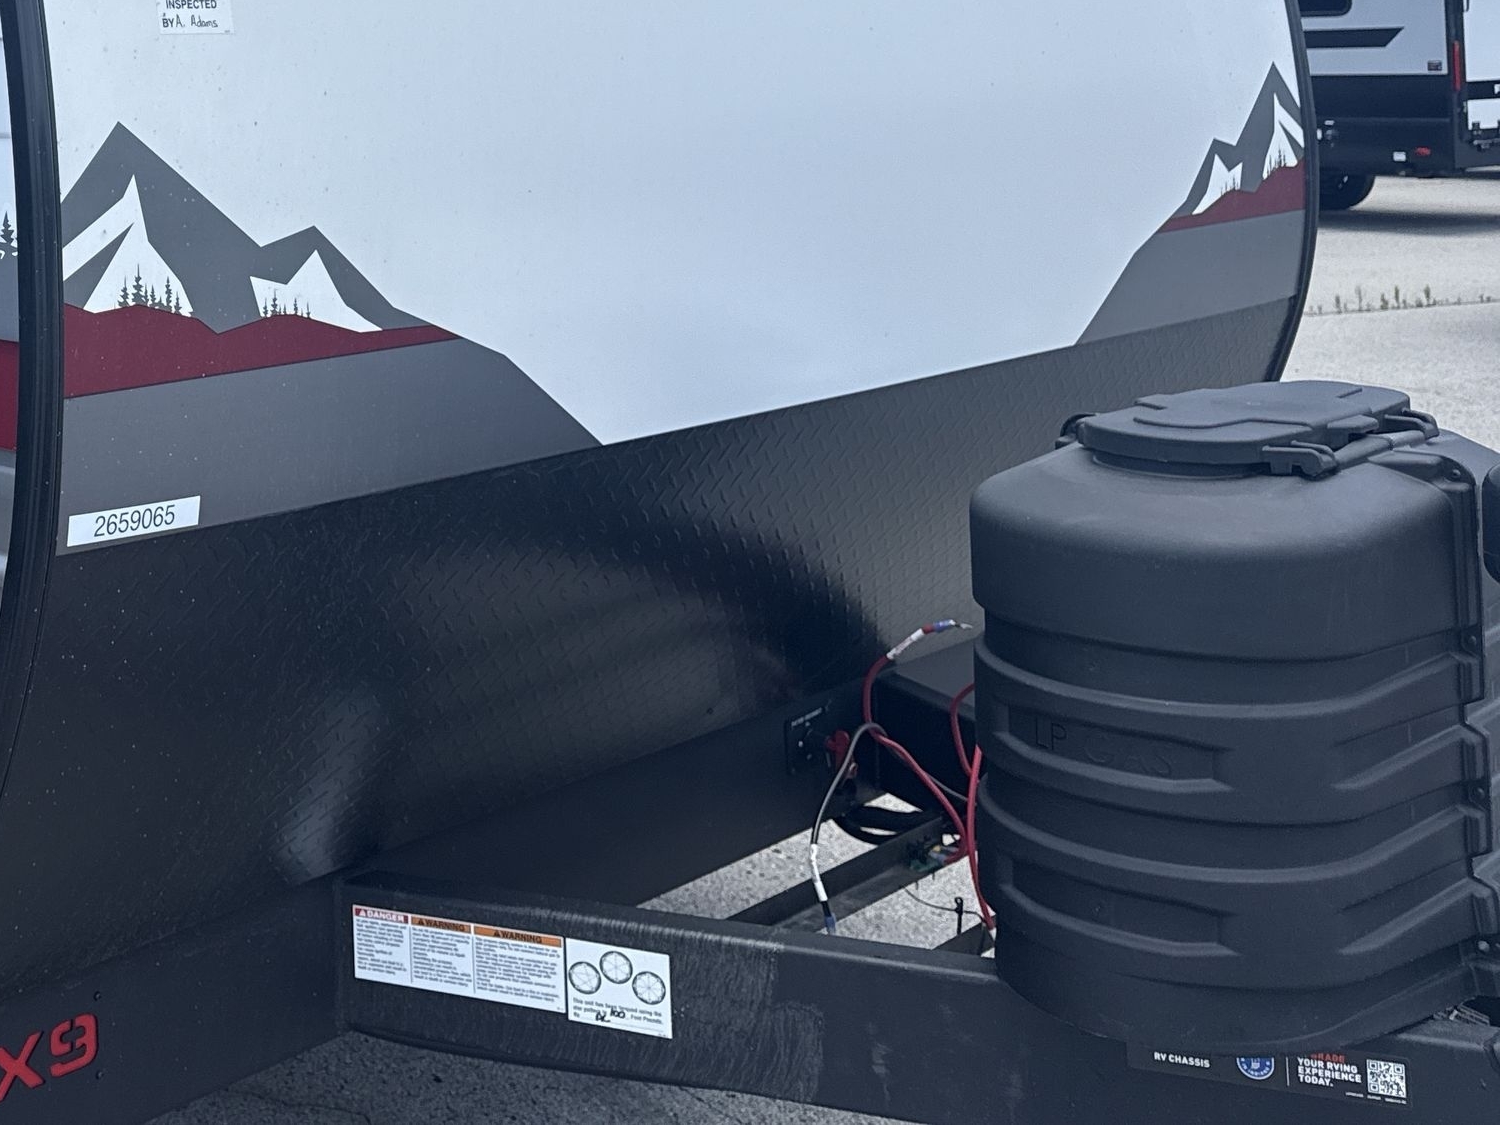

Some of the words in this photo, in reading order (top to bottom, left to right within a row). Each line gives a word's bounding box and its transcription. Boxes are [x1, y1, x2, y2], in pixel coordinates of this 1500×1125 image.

[165, 0, 217, 9] INSPECTED
[162, 18, 174, 28] BY
[190, 14, 218, 28] Adams
[93, 504, 176, 538] 2659065
[1035, 717, 1068, 753] LP
[367, 910, 405, 923] DANGER
[424, 918, 465, 932] WARNING
[500, 930, 542, 944] WARNING
[1154, 1052, 1167, 1062] RV
[1168, 1054, 1210, 1068] CHASSIS
[1297, 1057, 1324, 1069] YOUR
[1326, 1062, 1358, 1074] RVING
[1298, 1066, 1362, 1083] EXPERIENCE
[1298, 1074, 1334, 1087] TODAY.
